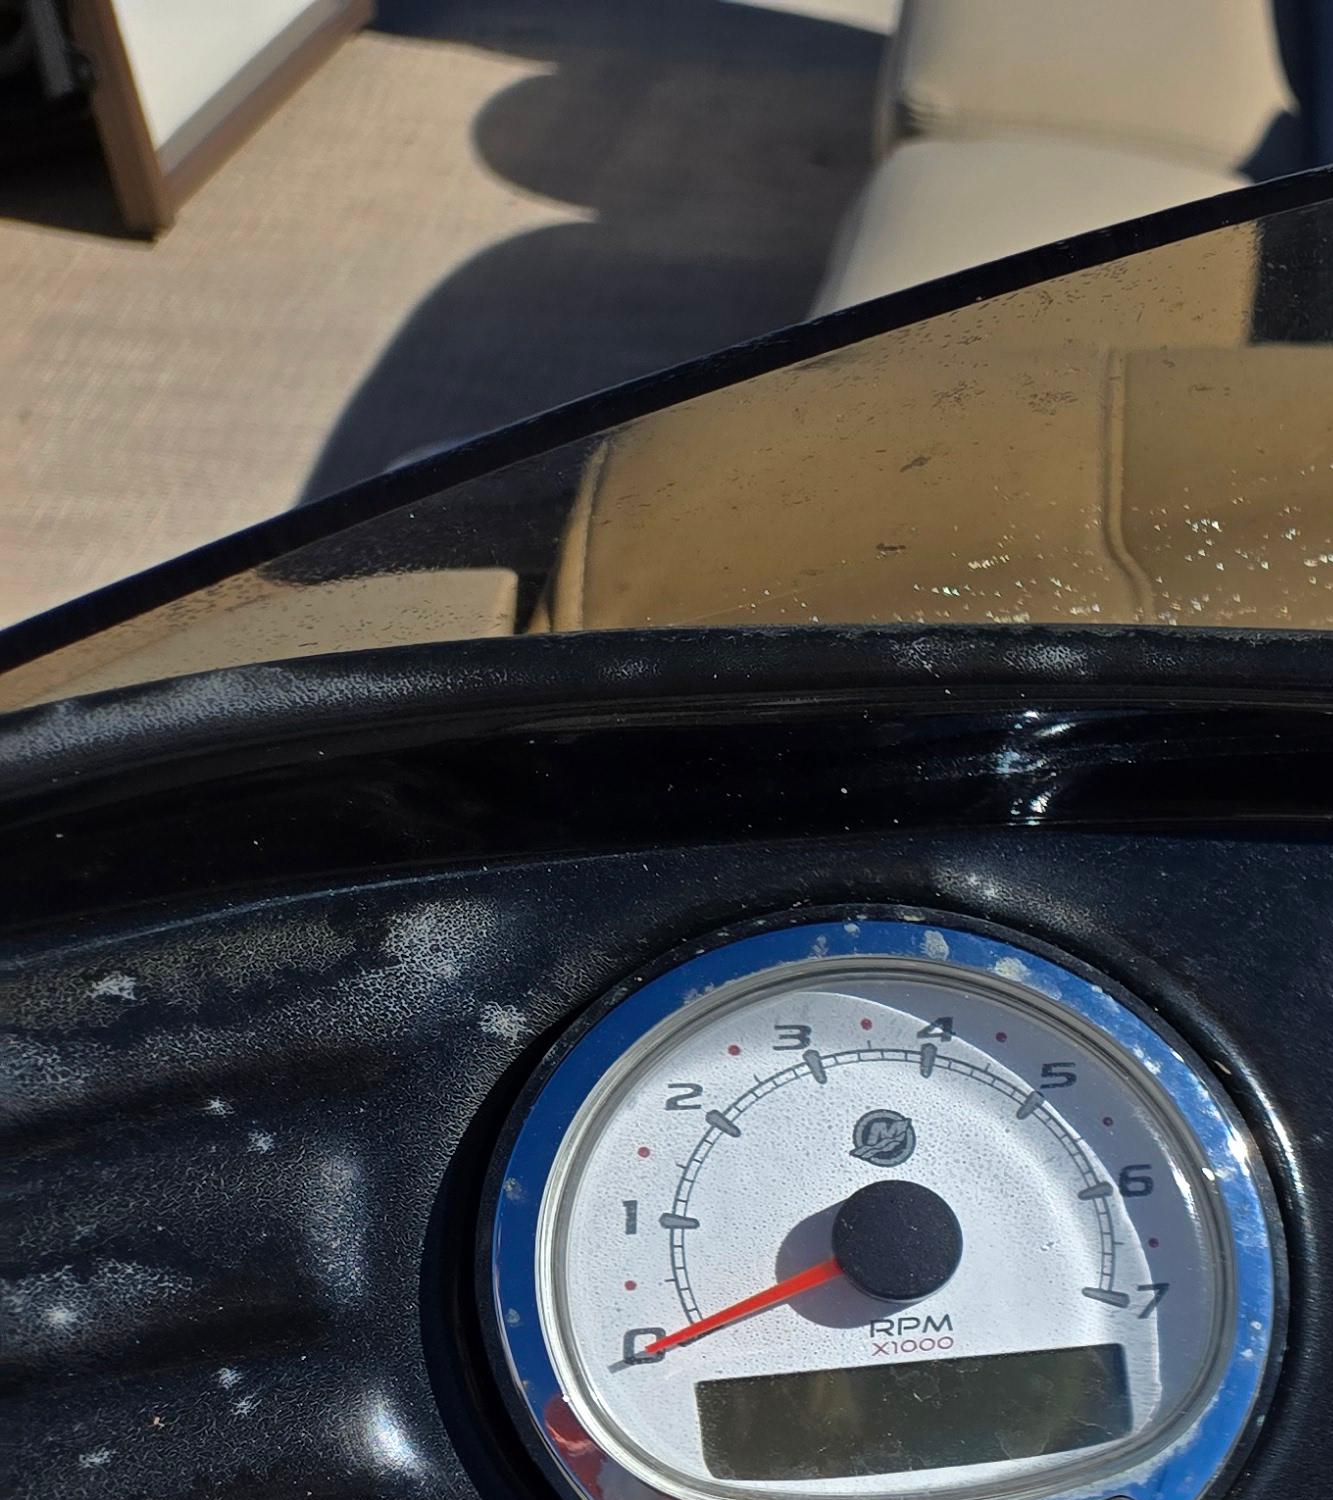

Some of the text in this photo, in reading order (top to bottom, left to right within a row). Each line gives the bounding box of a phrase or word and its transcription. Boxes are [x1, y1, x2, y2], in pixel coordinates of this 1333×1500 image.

[773, 1024, 813, 1052] 3
[918, 1015, 957, 1043] 4
[1039, 1061, 1077, 1090] 5
[665, 1082, 704, 1111] 2
[1117, 1164, 1154, 1197] 6
[624, 1200, 638, 1236] 1
[1136, 1283, 1171, 1320] 7
[869, 1313, 954, 1338] RPM
[622, 1328, 666, 1365] 0
[871, 1336, 955, 1357] X1000
